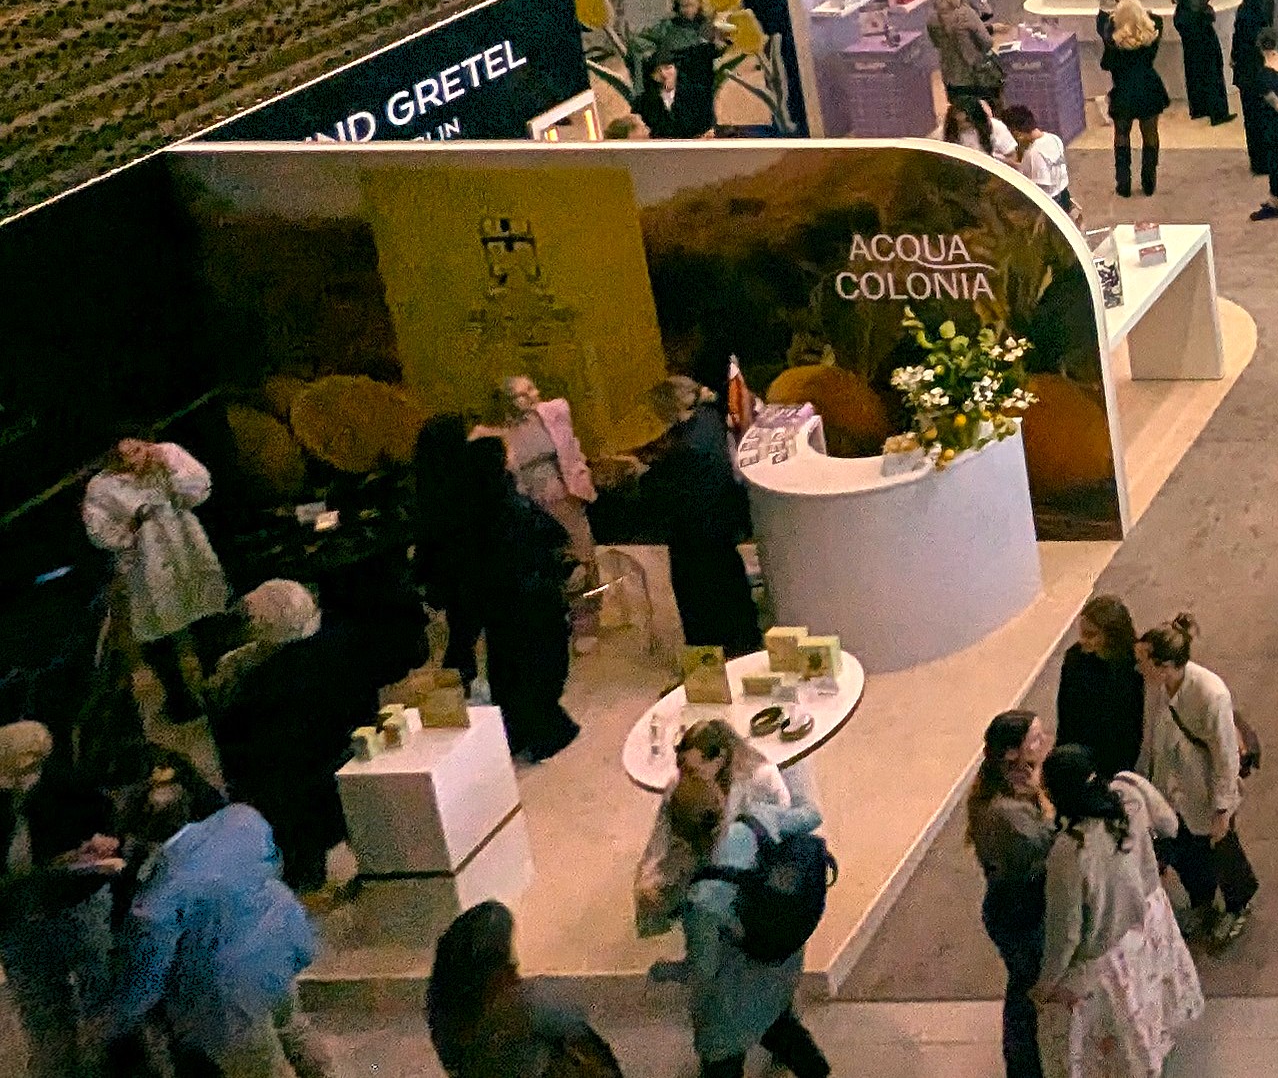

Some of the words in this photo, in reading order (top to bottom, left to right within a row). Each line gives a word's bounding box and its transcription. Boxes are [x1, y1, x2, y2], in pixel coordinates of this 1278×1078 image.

[386, 39, 527, 126] GRETEL
[850, 234, 990, 269] ACQUA
[835, 272, 997, 301] COLONIA
